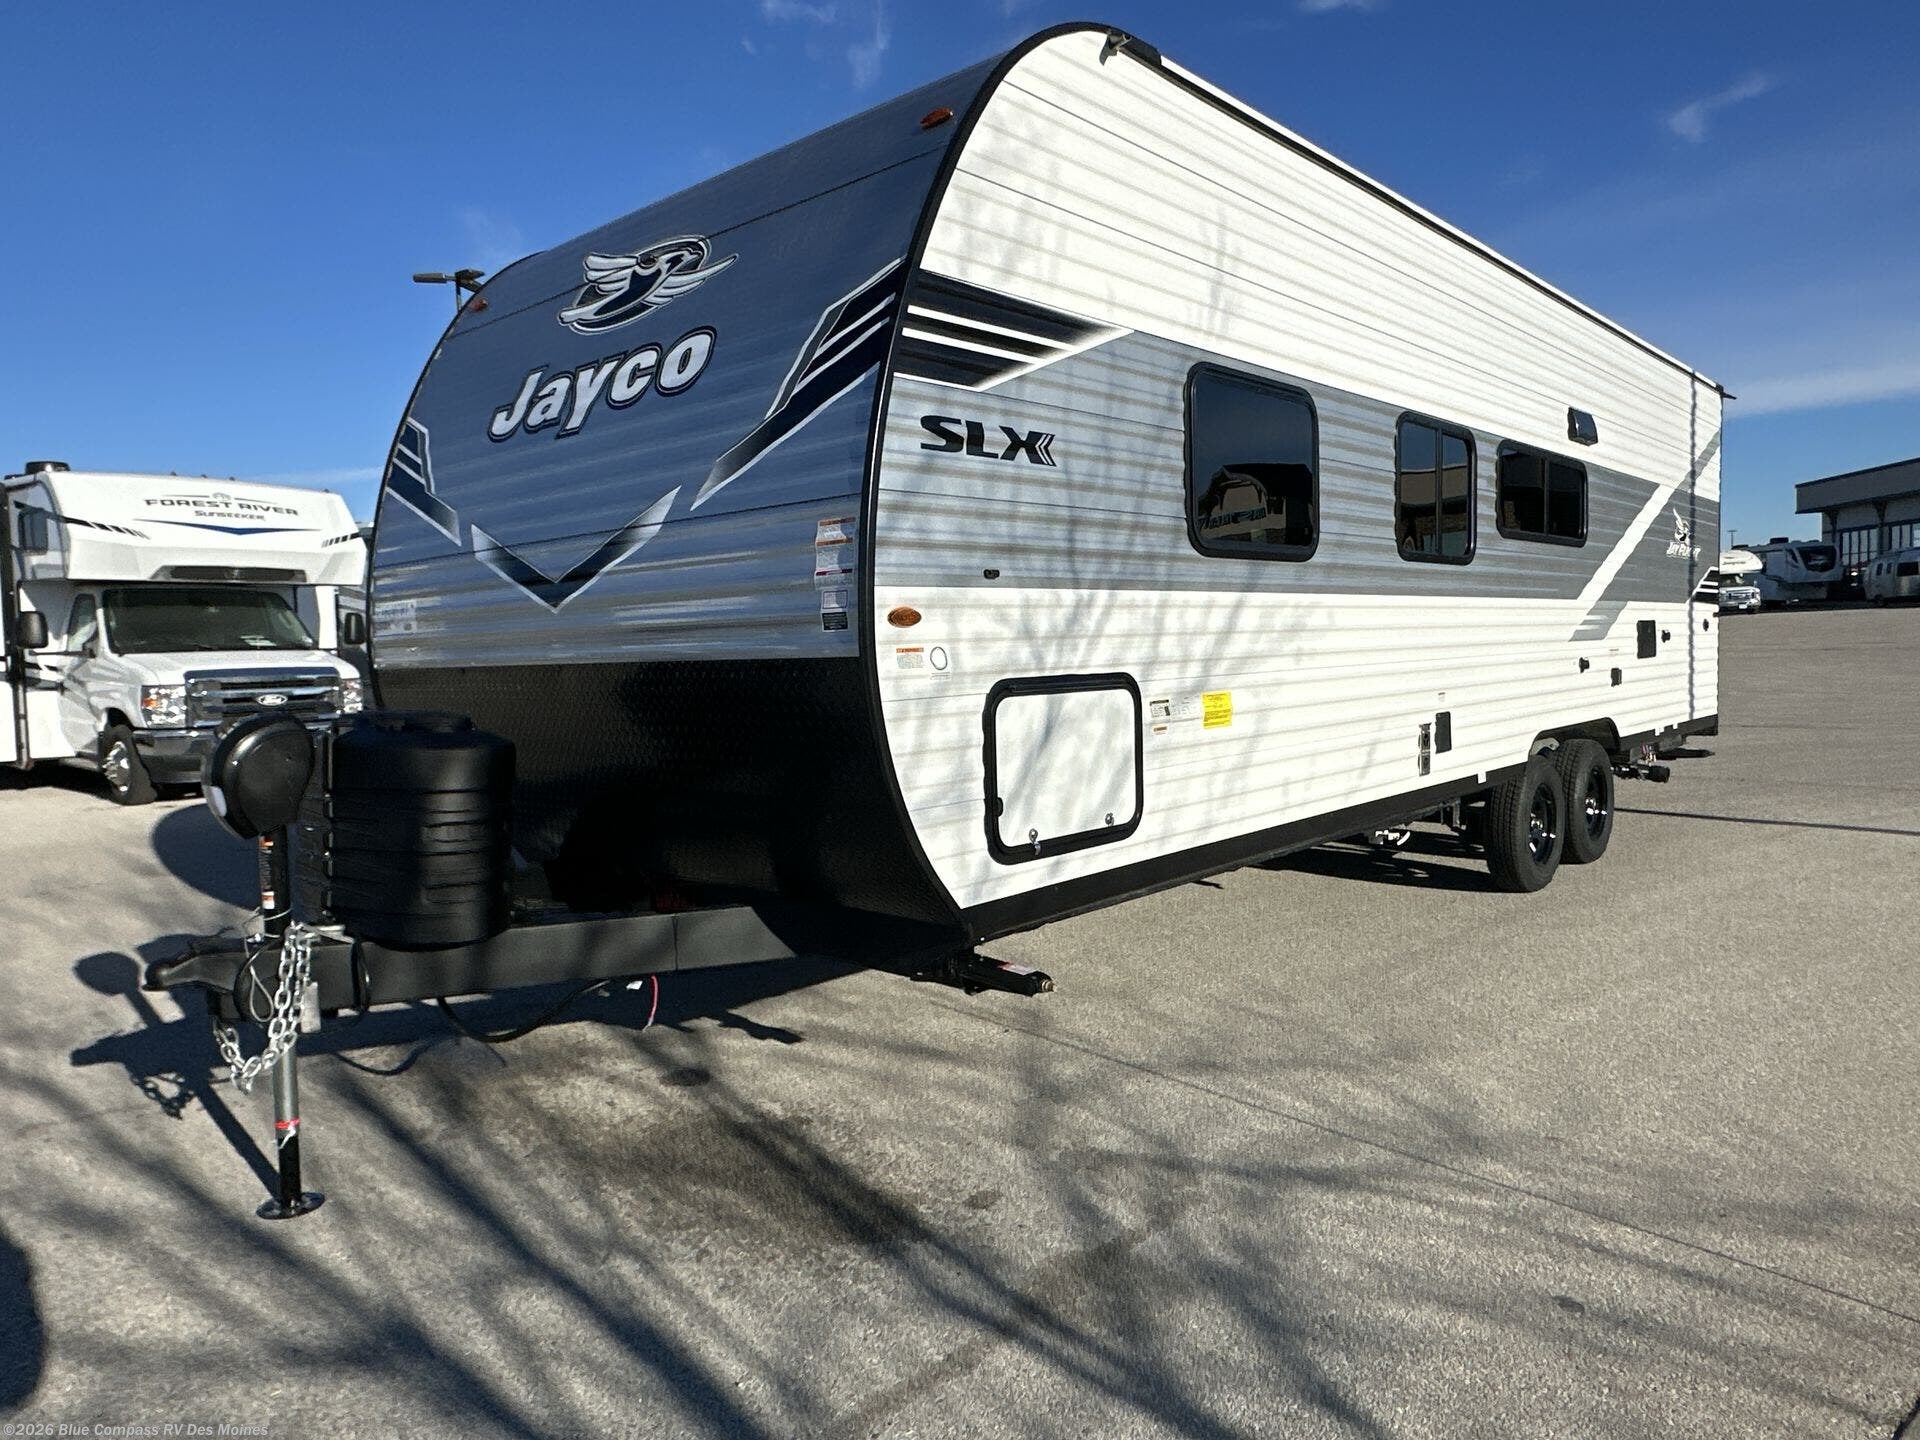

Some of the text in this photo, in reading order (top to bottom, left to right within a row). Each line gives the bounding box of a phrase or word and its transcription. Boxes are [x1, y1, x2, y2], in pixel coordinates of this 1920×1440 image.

[488, 326, 717, 442] Jayco
[920, 415, 1056, 467] SLX
[144, 499, 299, 516] FOREST RIVER
